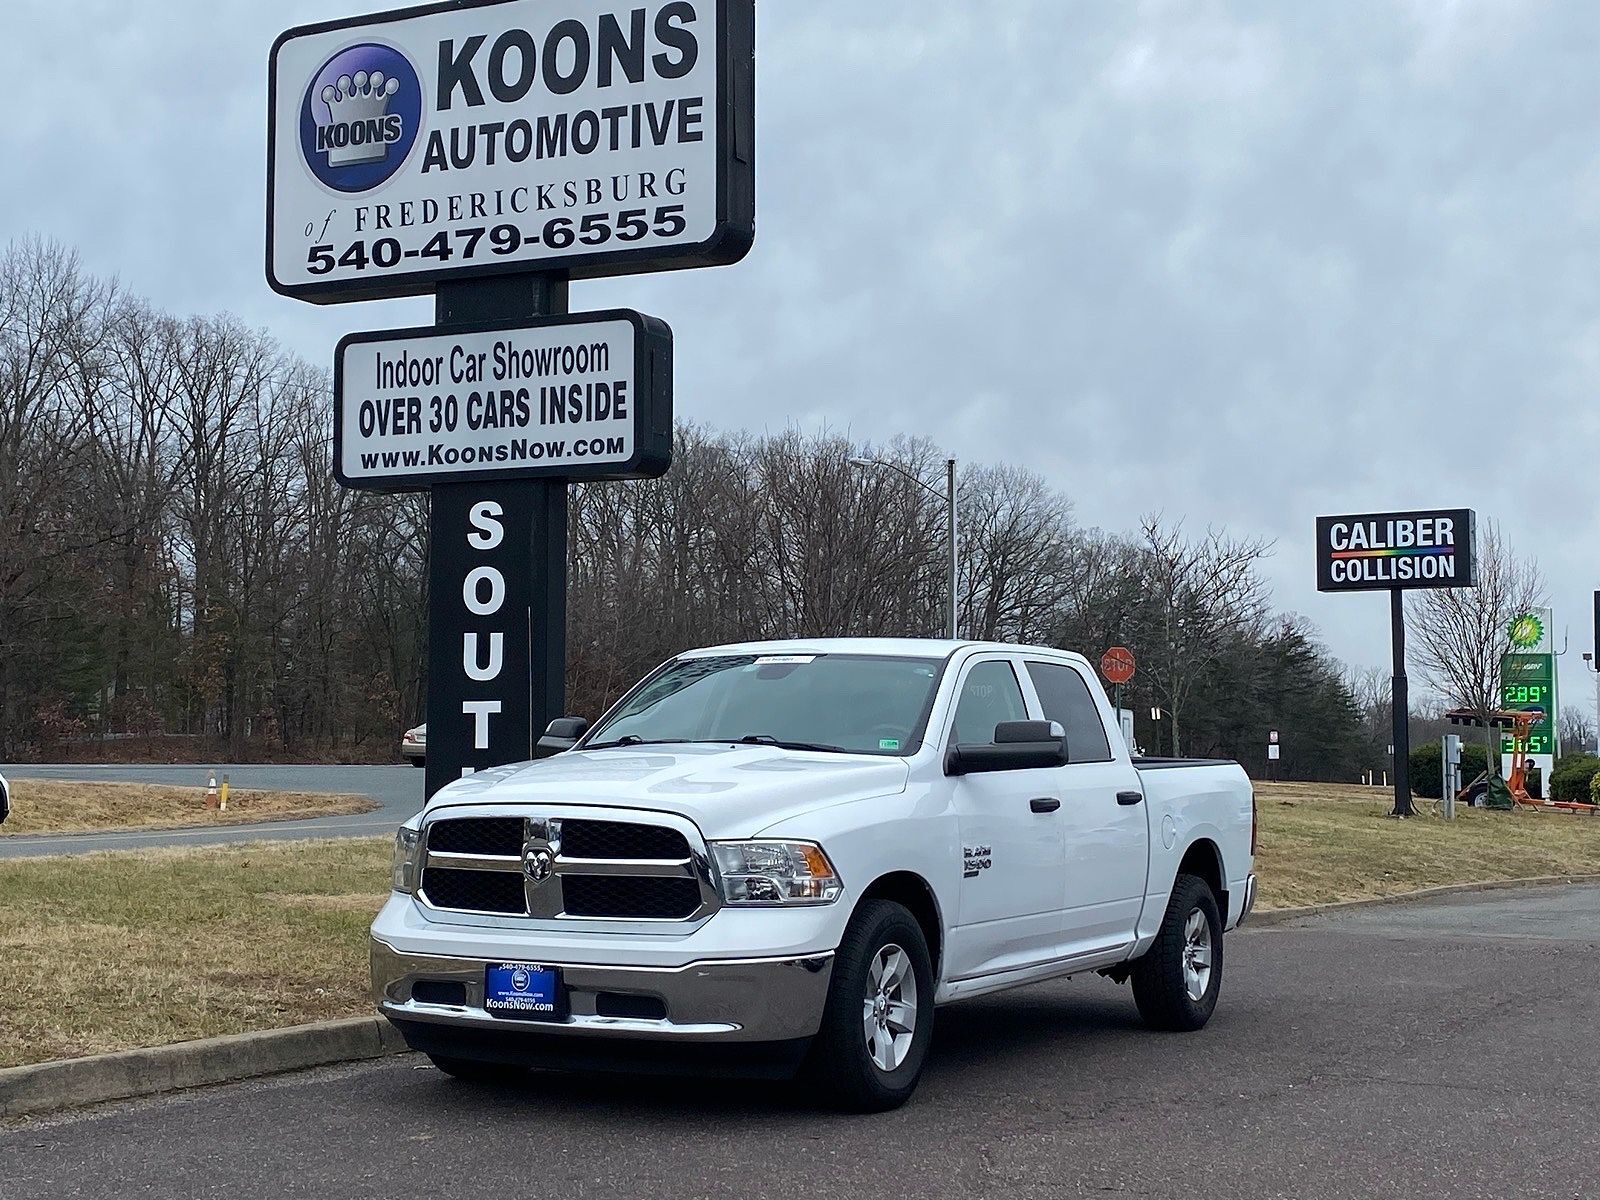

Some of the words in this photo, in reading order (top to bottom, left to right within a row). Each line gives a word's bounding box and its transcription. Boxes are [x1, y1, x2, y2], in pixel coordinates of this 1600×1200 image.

[436, 1, 698, 111] KOONS
[316, 114, 402, 151] KOONS
[421, 97, 703, 174] AUTOMOTIVE
[355, 168, 687, 232] FREDERICKSBURG
[306, 205, 686, 275] 540-479-6555
[376, 351, 443, 389] Indoor
[450, 345, 486, 385] Car
[493, 341, 609, 380] Showroom
[359, 398, 422, 438] OVER
[430, 394, 458, 433] 30
[467, 388, 530, 430] CARS
[540, 381, 627, 425] INSIDE
[1330, 518, 1455, 550] CALIBER
[1331, 555, 1455, 582] COLLISION
[462, 501, 506, 777] SOUT
[1105, 658, 1132, 671] STOP
[486, 998, 554, 1012] KoonsNow.com
